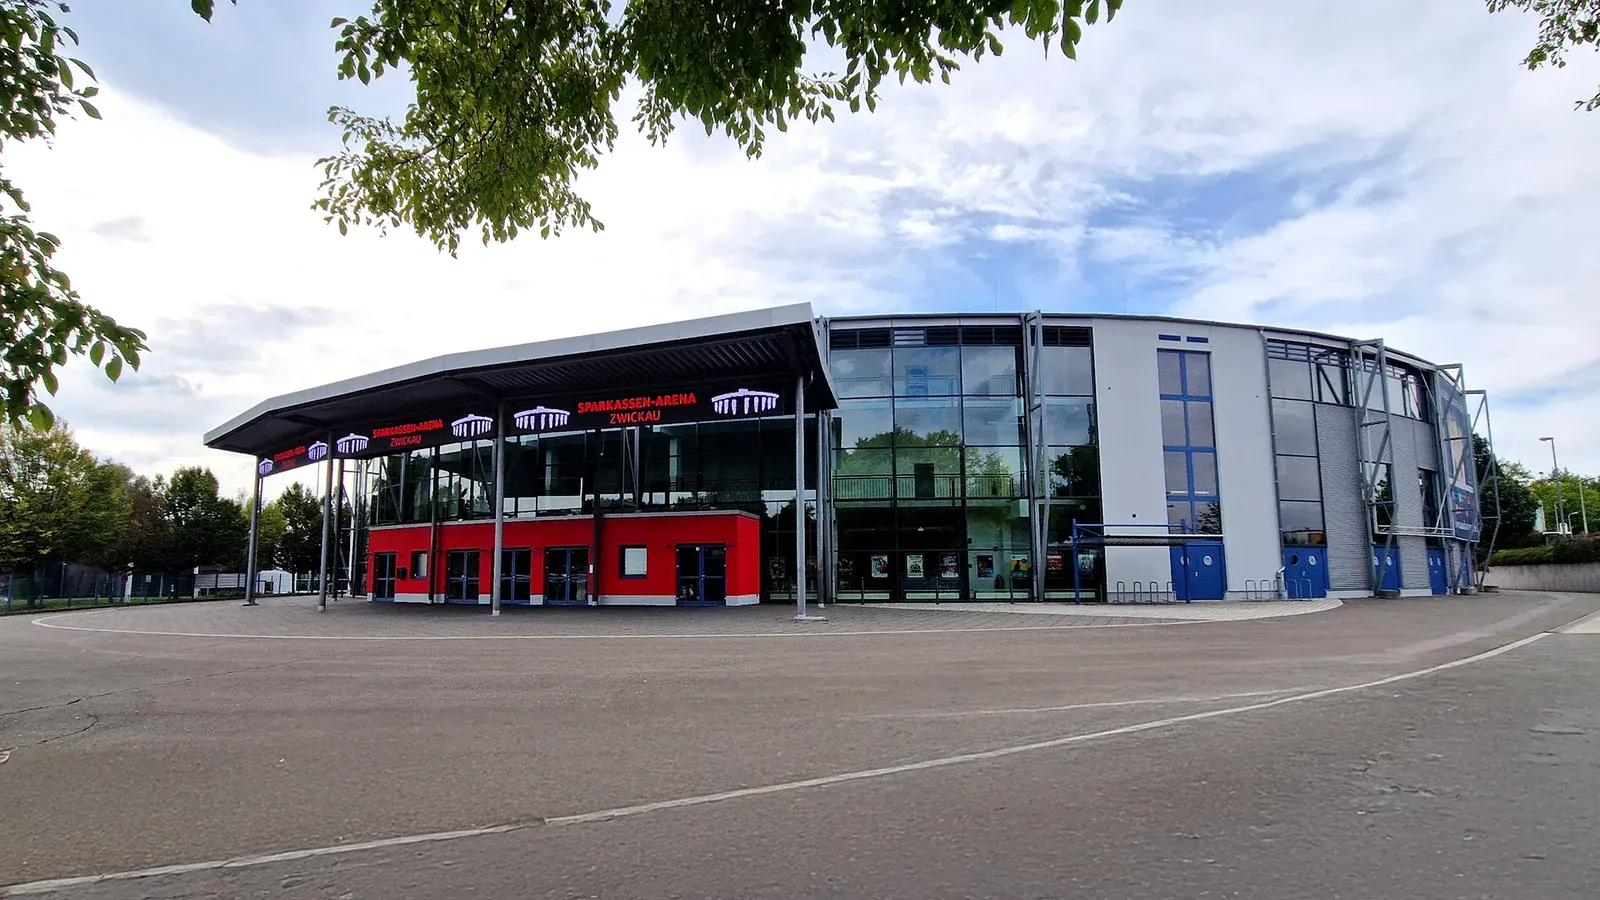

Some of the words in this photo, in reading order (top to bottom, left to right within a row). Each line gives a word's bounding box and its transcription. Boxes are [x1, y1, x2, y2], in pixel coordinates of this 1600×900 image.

[577, 392, 696, 414] SPARKASSEN-ARENA
[609, 410, 661, 425] ZWICKAU
[372, 418, 444, 438] SPARKASSEN-ARENA
[390, 434, 422, 447] ZWICKAU
